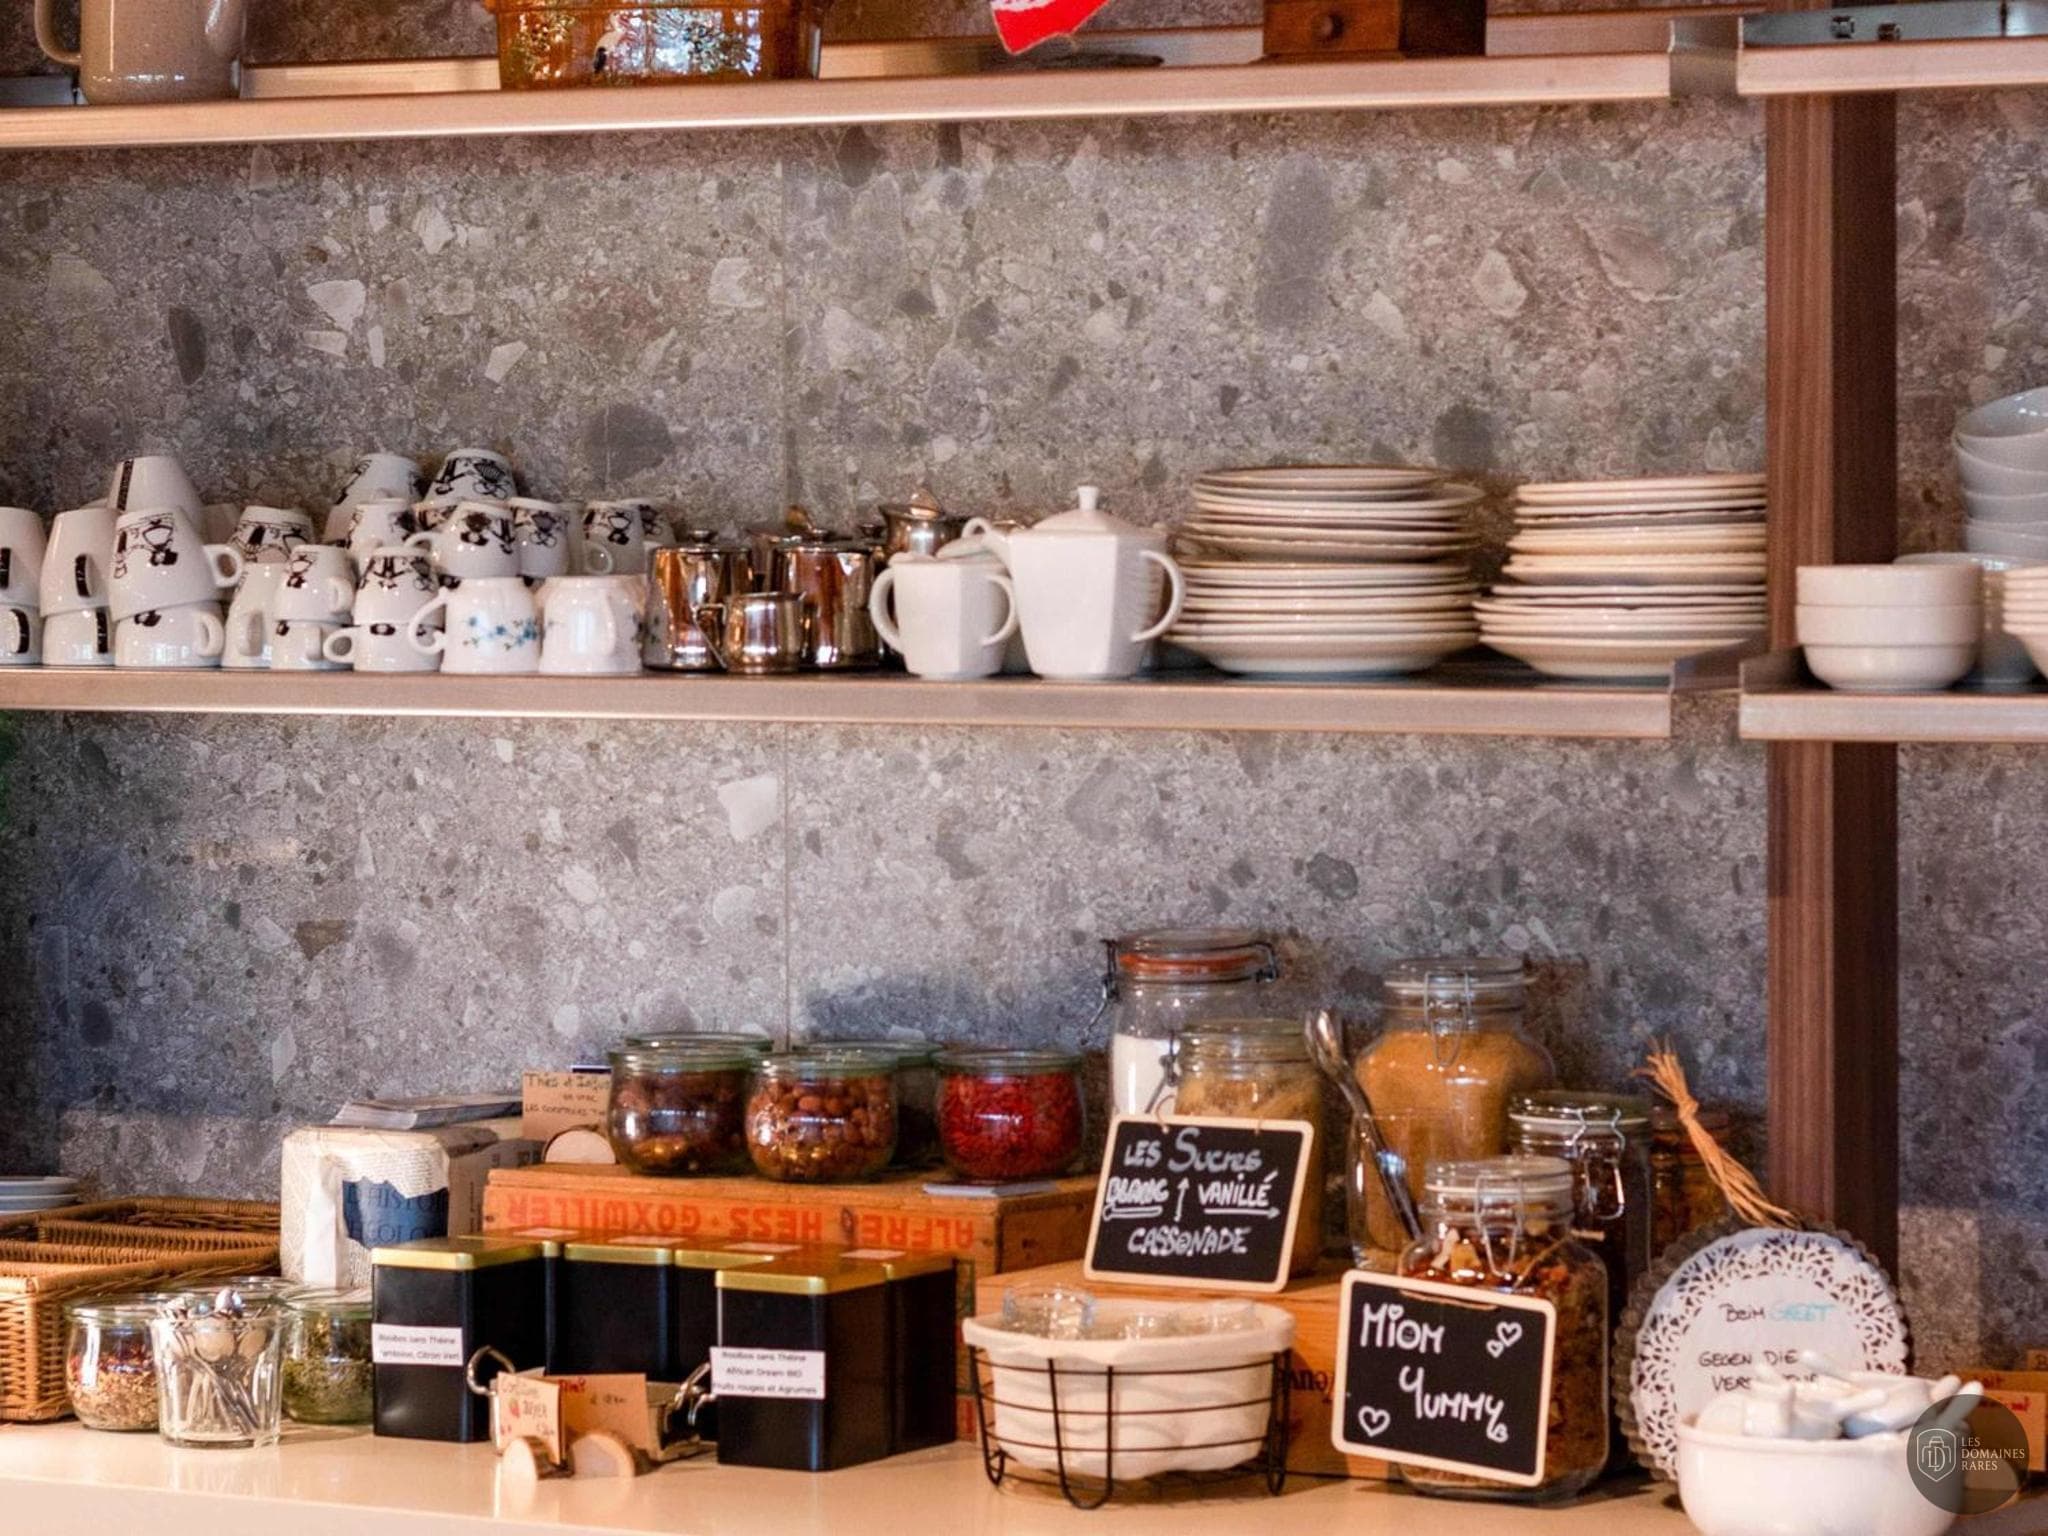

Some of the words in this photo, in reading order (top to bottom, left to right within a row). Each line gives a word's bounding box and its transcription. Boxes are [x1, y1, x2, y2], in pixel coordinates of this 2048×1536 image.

[1123, 1140, 1162, 1167] LES
[507, 1194, 701, 1233] GOXWILLER
[729, 1207, 822, 1241] HESS
[1127, 1226, 1250, 1256] CASSONADE
[1698, 1350, 1753, 1367] GEGEN
